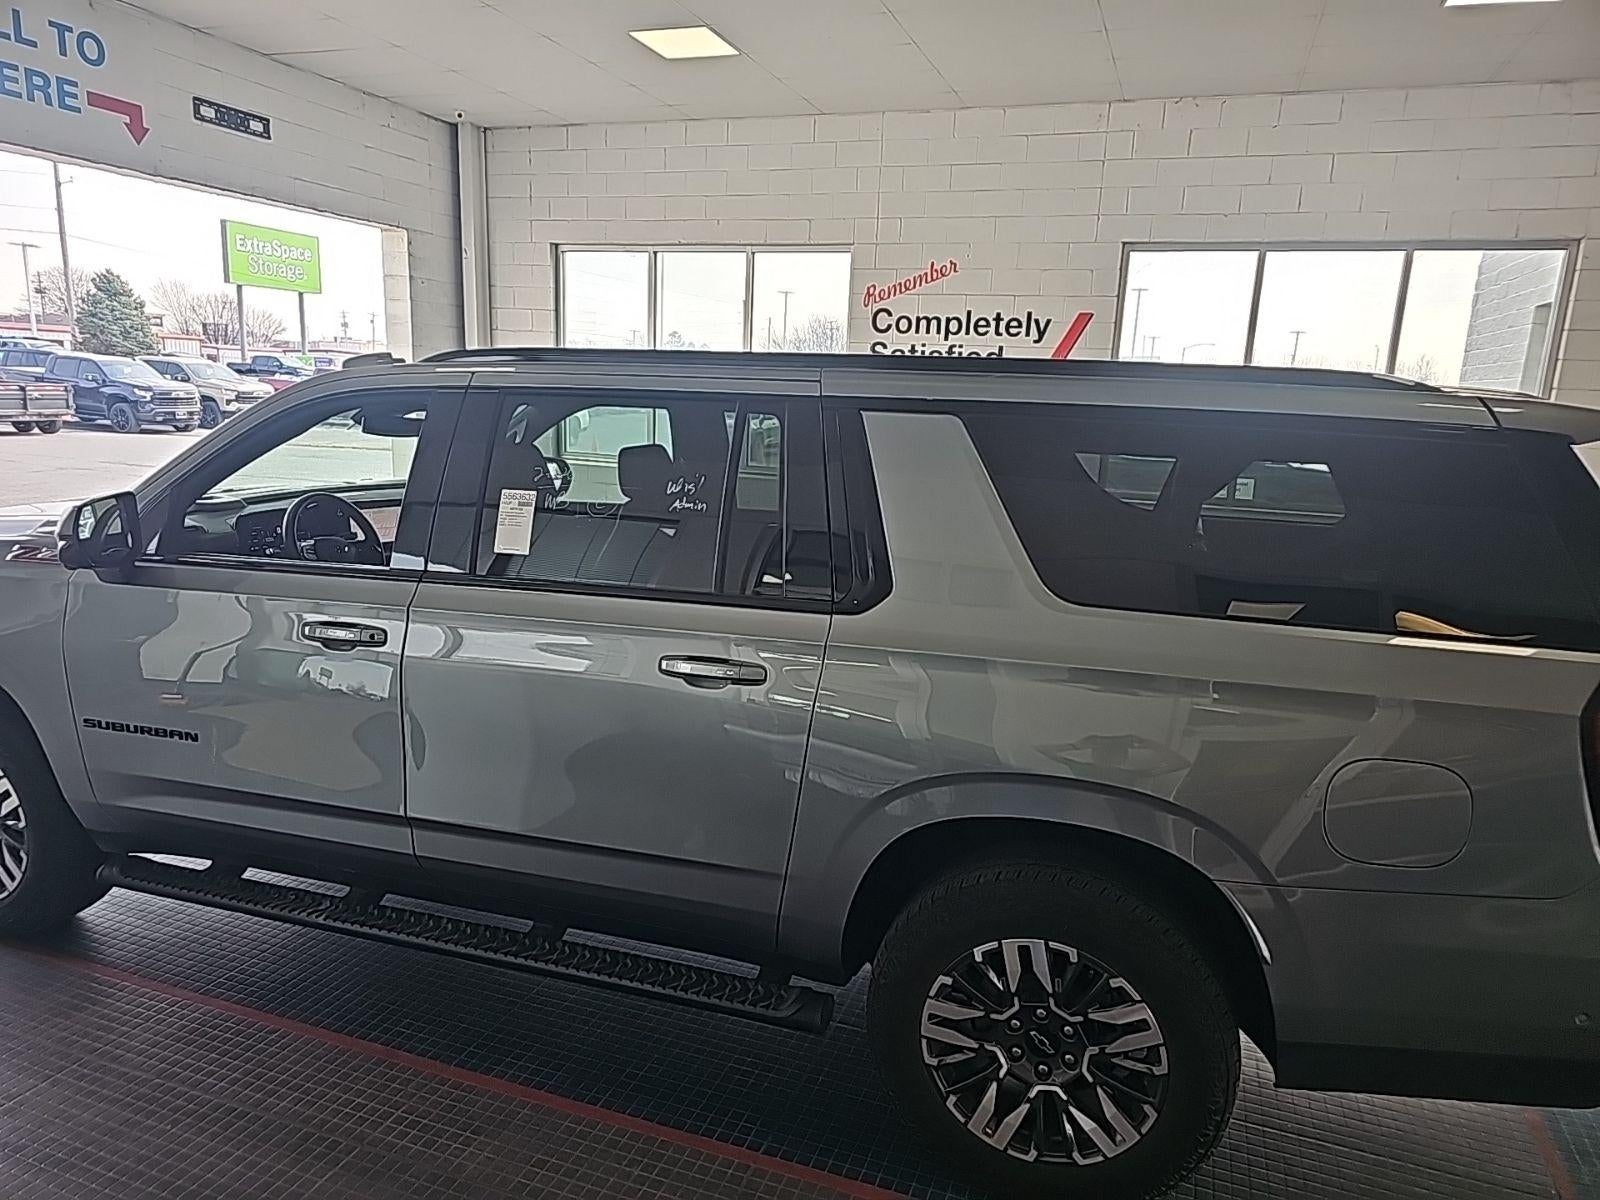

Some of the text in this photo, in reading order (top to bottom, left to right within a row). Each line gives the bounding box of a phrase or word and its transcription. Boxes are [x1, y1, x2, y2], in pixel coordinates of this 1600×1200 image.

[47, 19, 106, 67] TO
[0, 60, 82, 114] ERE
[235, 233, 312, 262] ExtraSpace
[248, 254, 304, 282] Storage
[863, 259, 959, 307] Remember
[871, 307, 1052, 344] Completely
[669, 496, 707, 512] Admin
[82, 717, 199, 743] SUBURBAN
